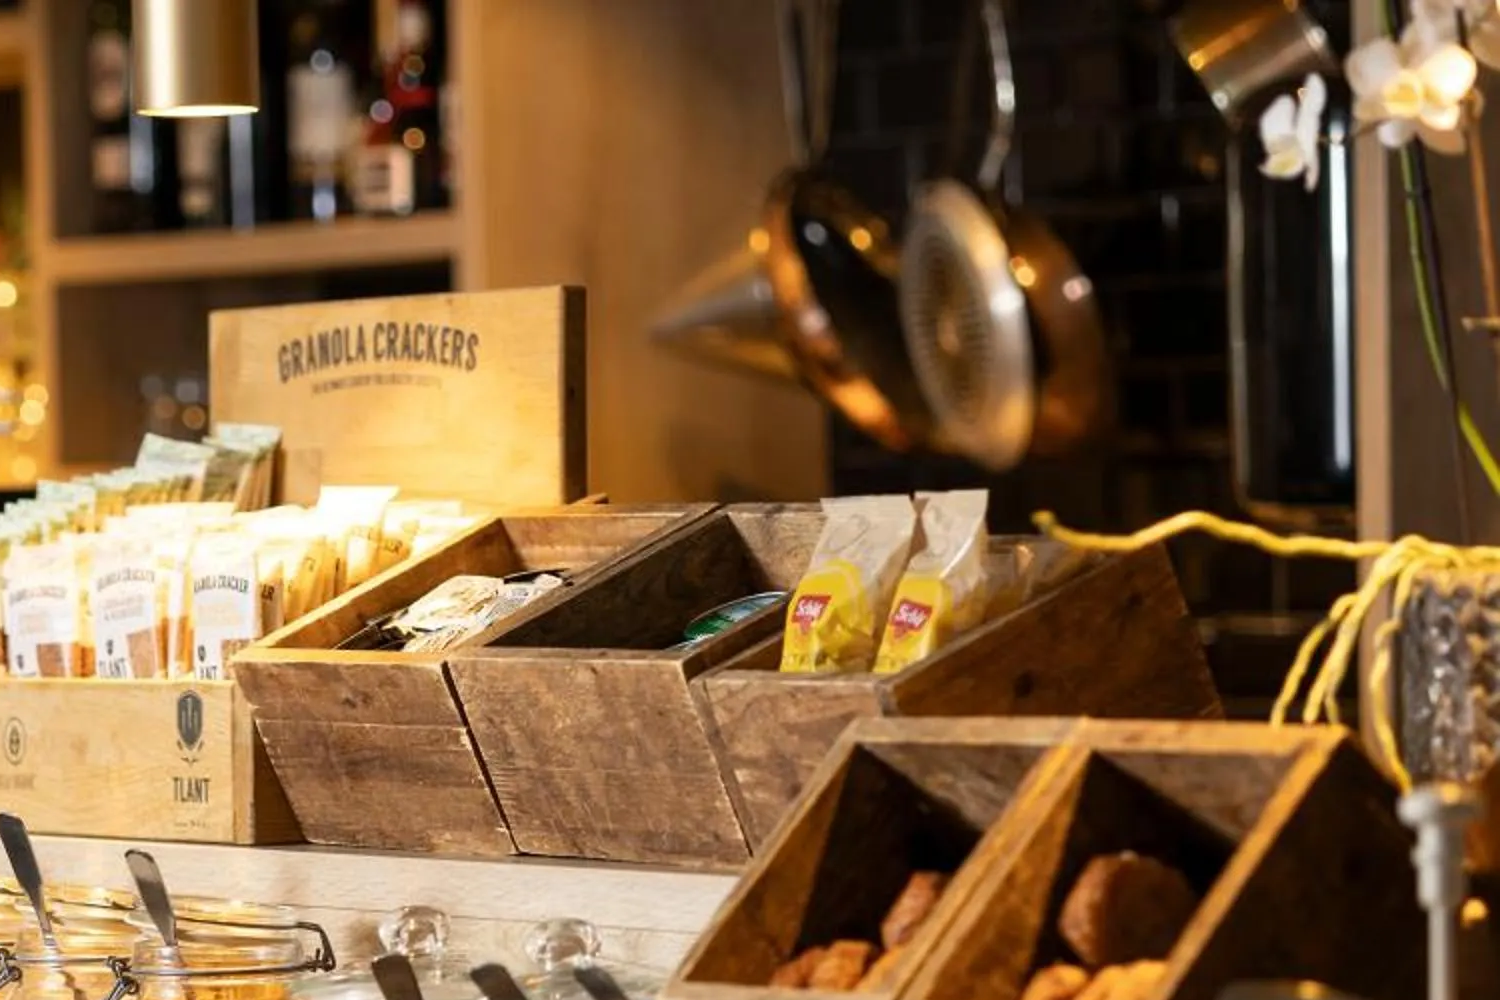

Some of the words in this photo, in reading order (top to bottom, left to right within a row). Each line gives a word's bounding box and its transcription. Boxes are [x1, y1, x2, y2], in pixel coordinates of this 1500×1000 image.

[278, 324, 368, 385] GRANOLA
[372, 321, 480, 372] CRACKERS
[172, 776, 210, 804] TLANT
